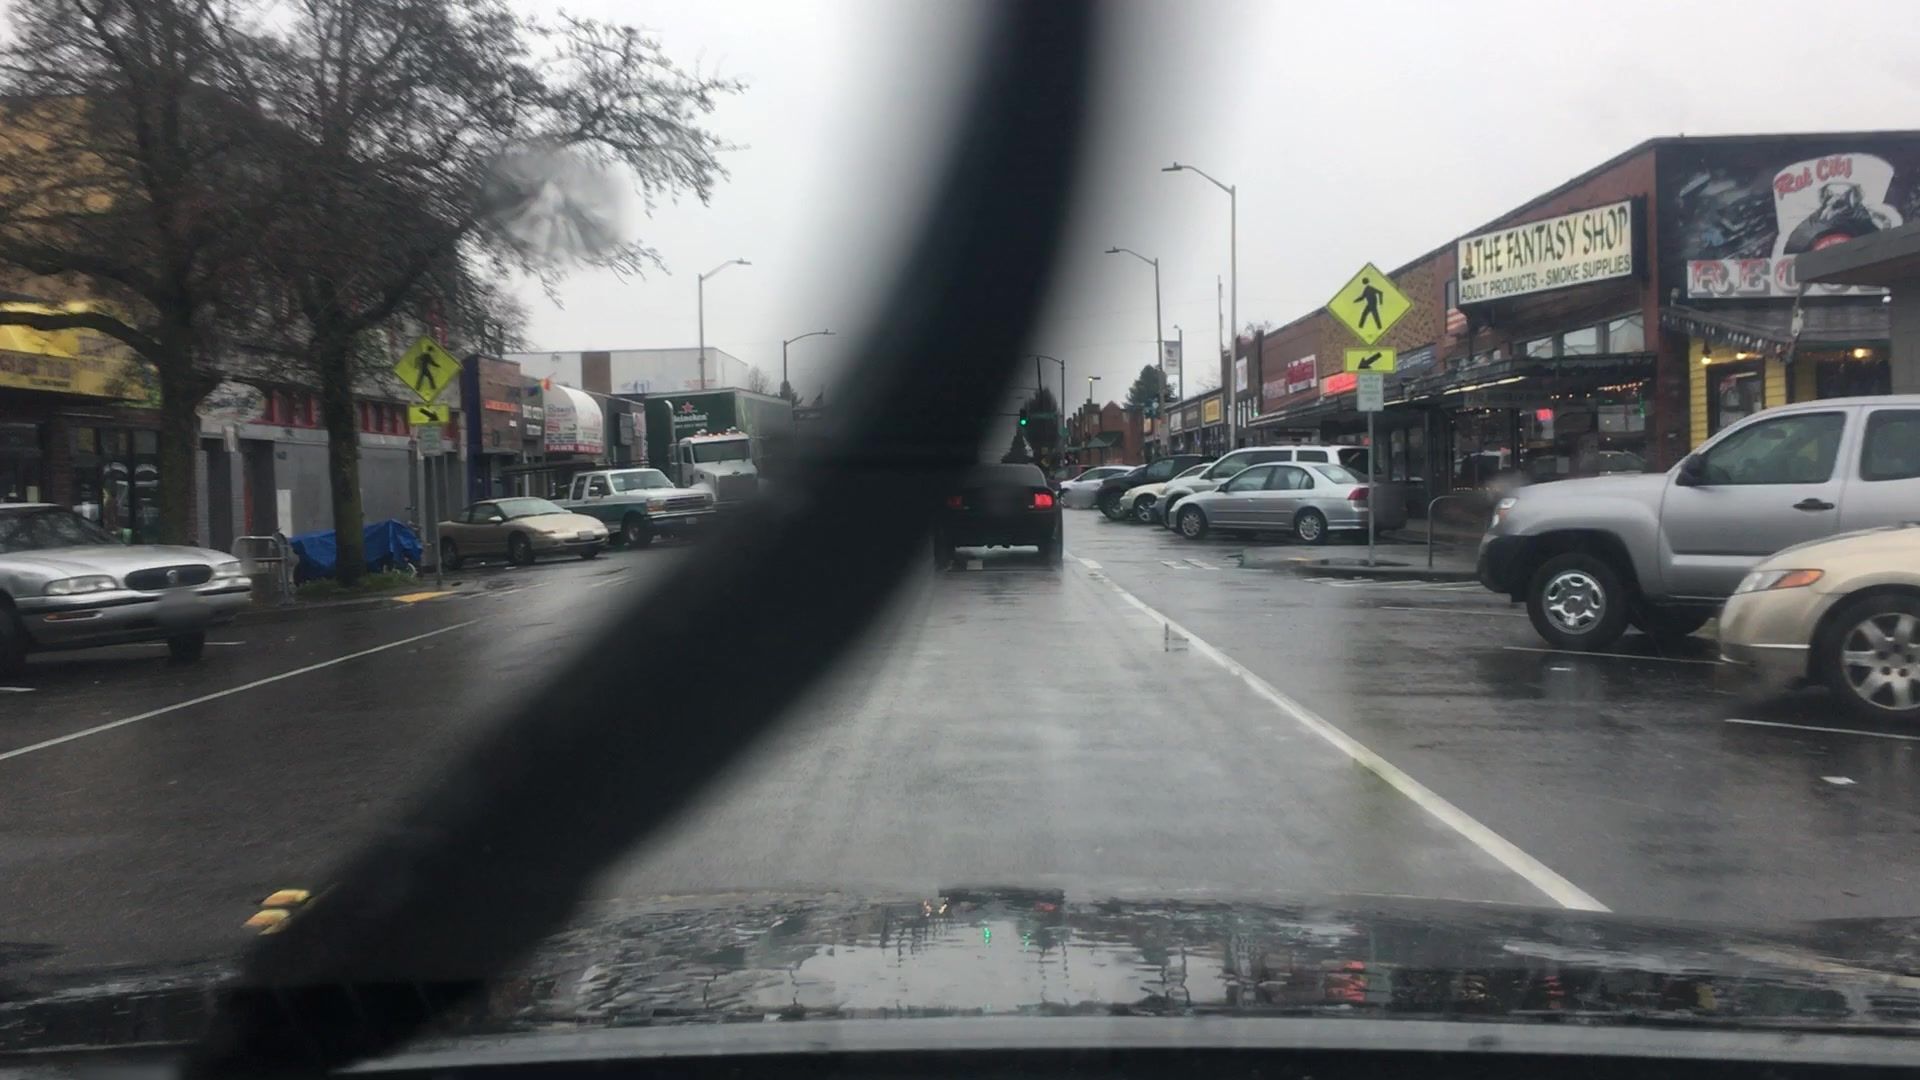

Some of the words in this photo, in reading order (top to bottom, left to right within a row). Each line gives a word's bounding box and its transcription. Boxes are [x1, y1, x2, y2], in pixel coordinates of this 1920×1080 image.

[1774, 166, 1813, 200] Rat
[1815, 154, 1853, 182] City
[1474, 234, 1504, 275] THE
[1506, 216, 1578, 270] FANTASY
[1582, 205, 1628, 255] SHOP
[1461, 281, 1489, 301] ADULT
[1490, 273, 1538, 295] PRODUCTS
[1546, 267, 1579, 287] SMOKE
[1582, 253, 1631, 279] SUPPLIES
